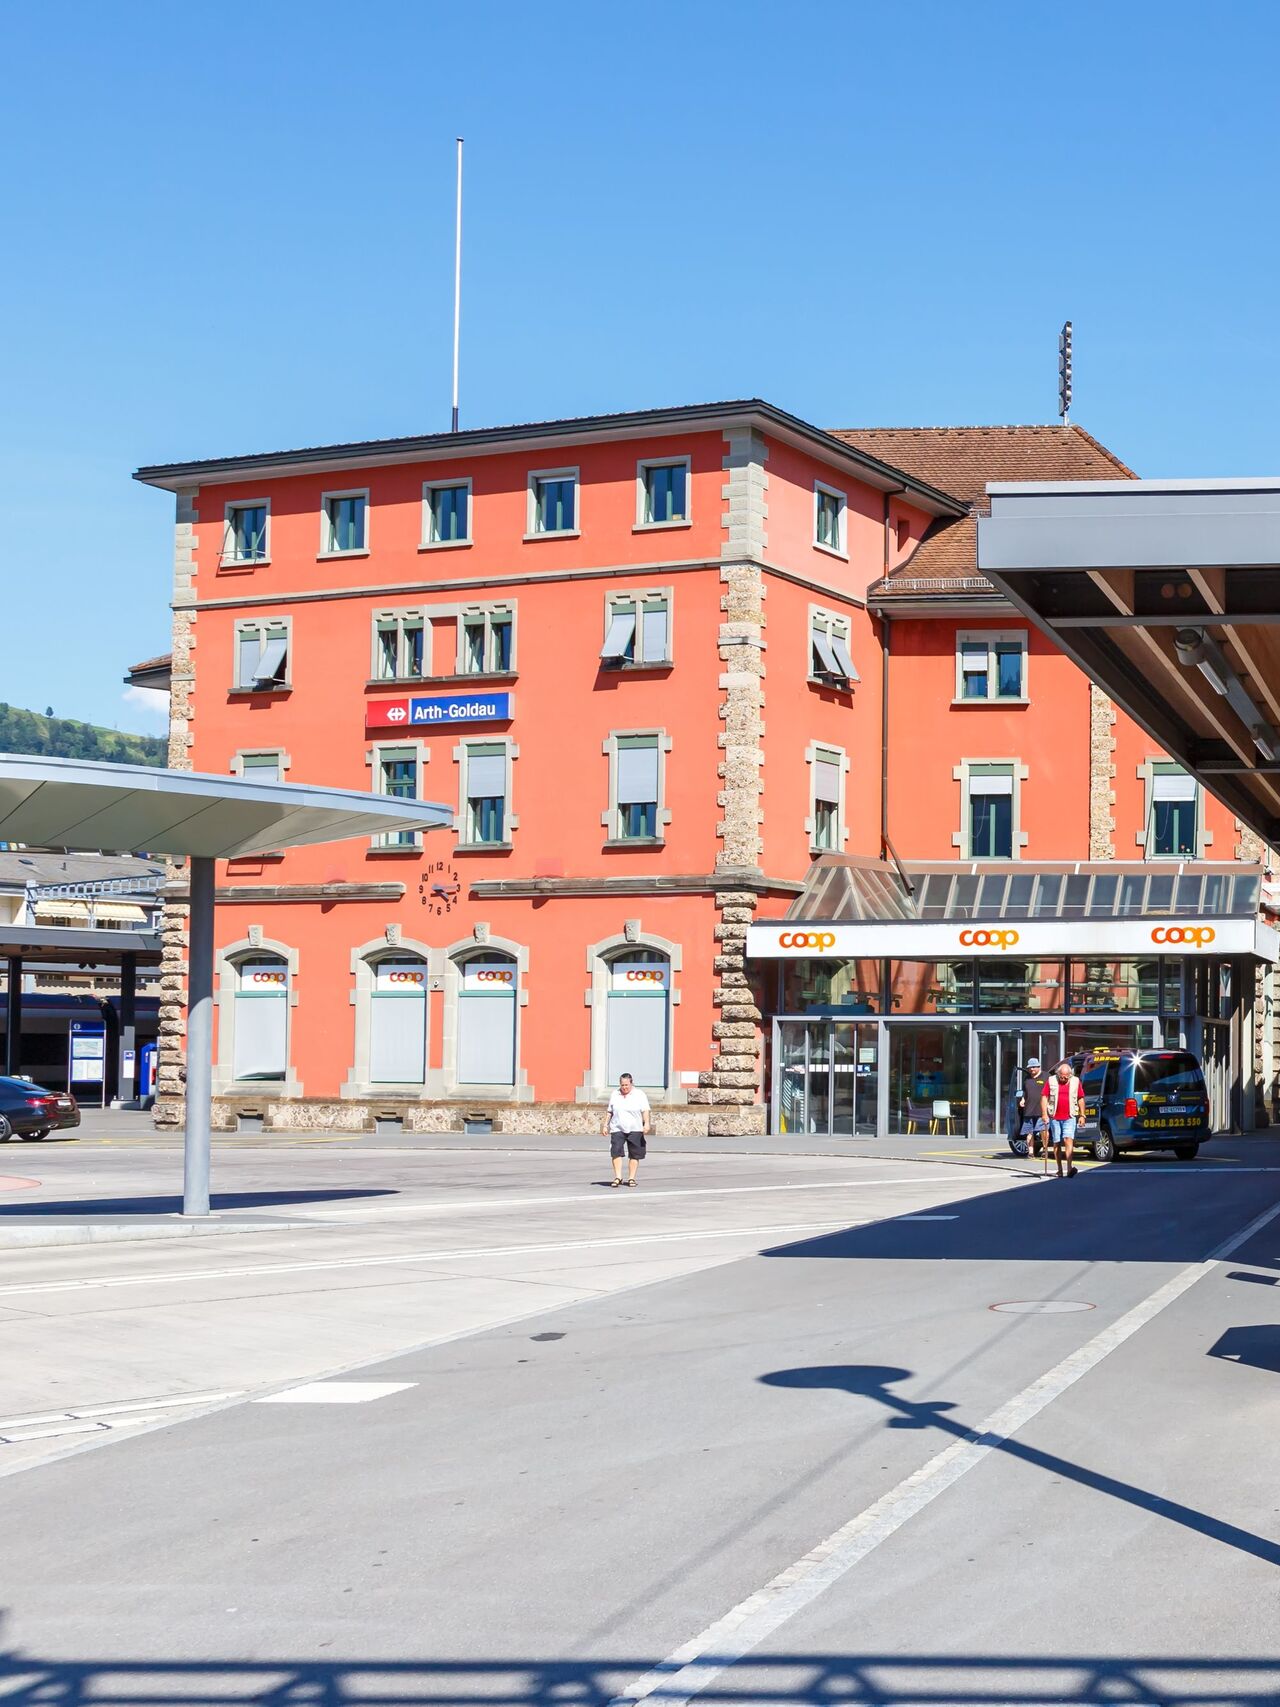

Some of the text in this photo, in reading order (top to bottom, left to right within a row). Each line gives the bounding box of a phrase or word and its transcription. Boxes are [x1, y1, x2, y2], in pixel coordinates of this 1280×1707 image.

[414, 703, 496, 720] Arth-Goldau
[779, 932, 836, 952] coop
[959, 930, 1019, 950] coop
[1151, 927, 1215, 948] coop
[253, 972, 286, 984] coop
[389, 971, 424, 984] coop
[477, 970, 513, 984] coop
[626, 970, 664, 984] coop
[1143, 1117, 1201, 1128] 0848 822 550
